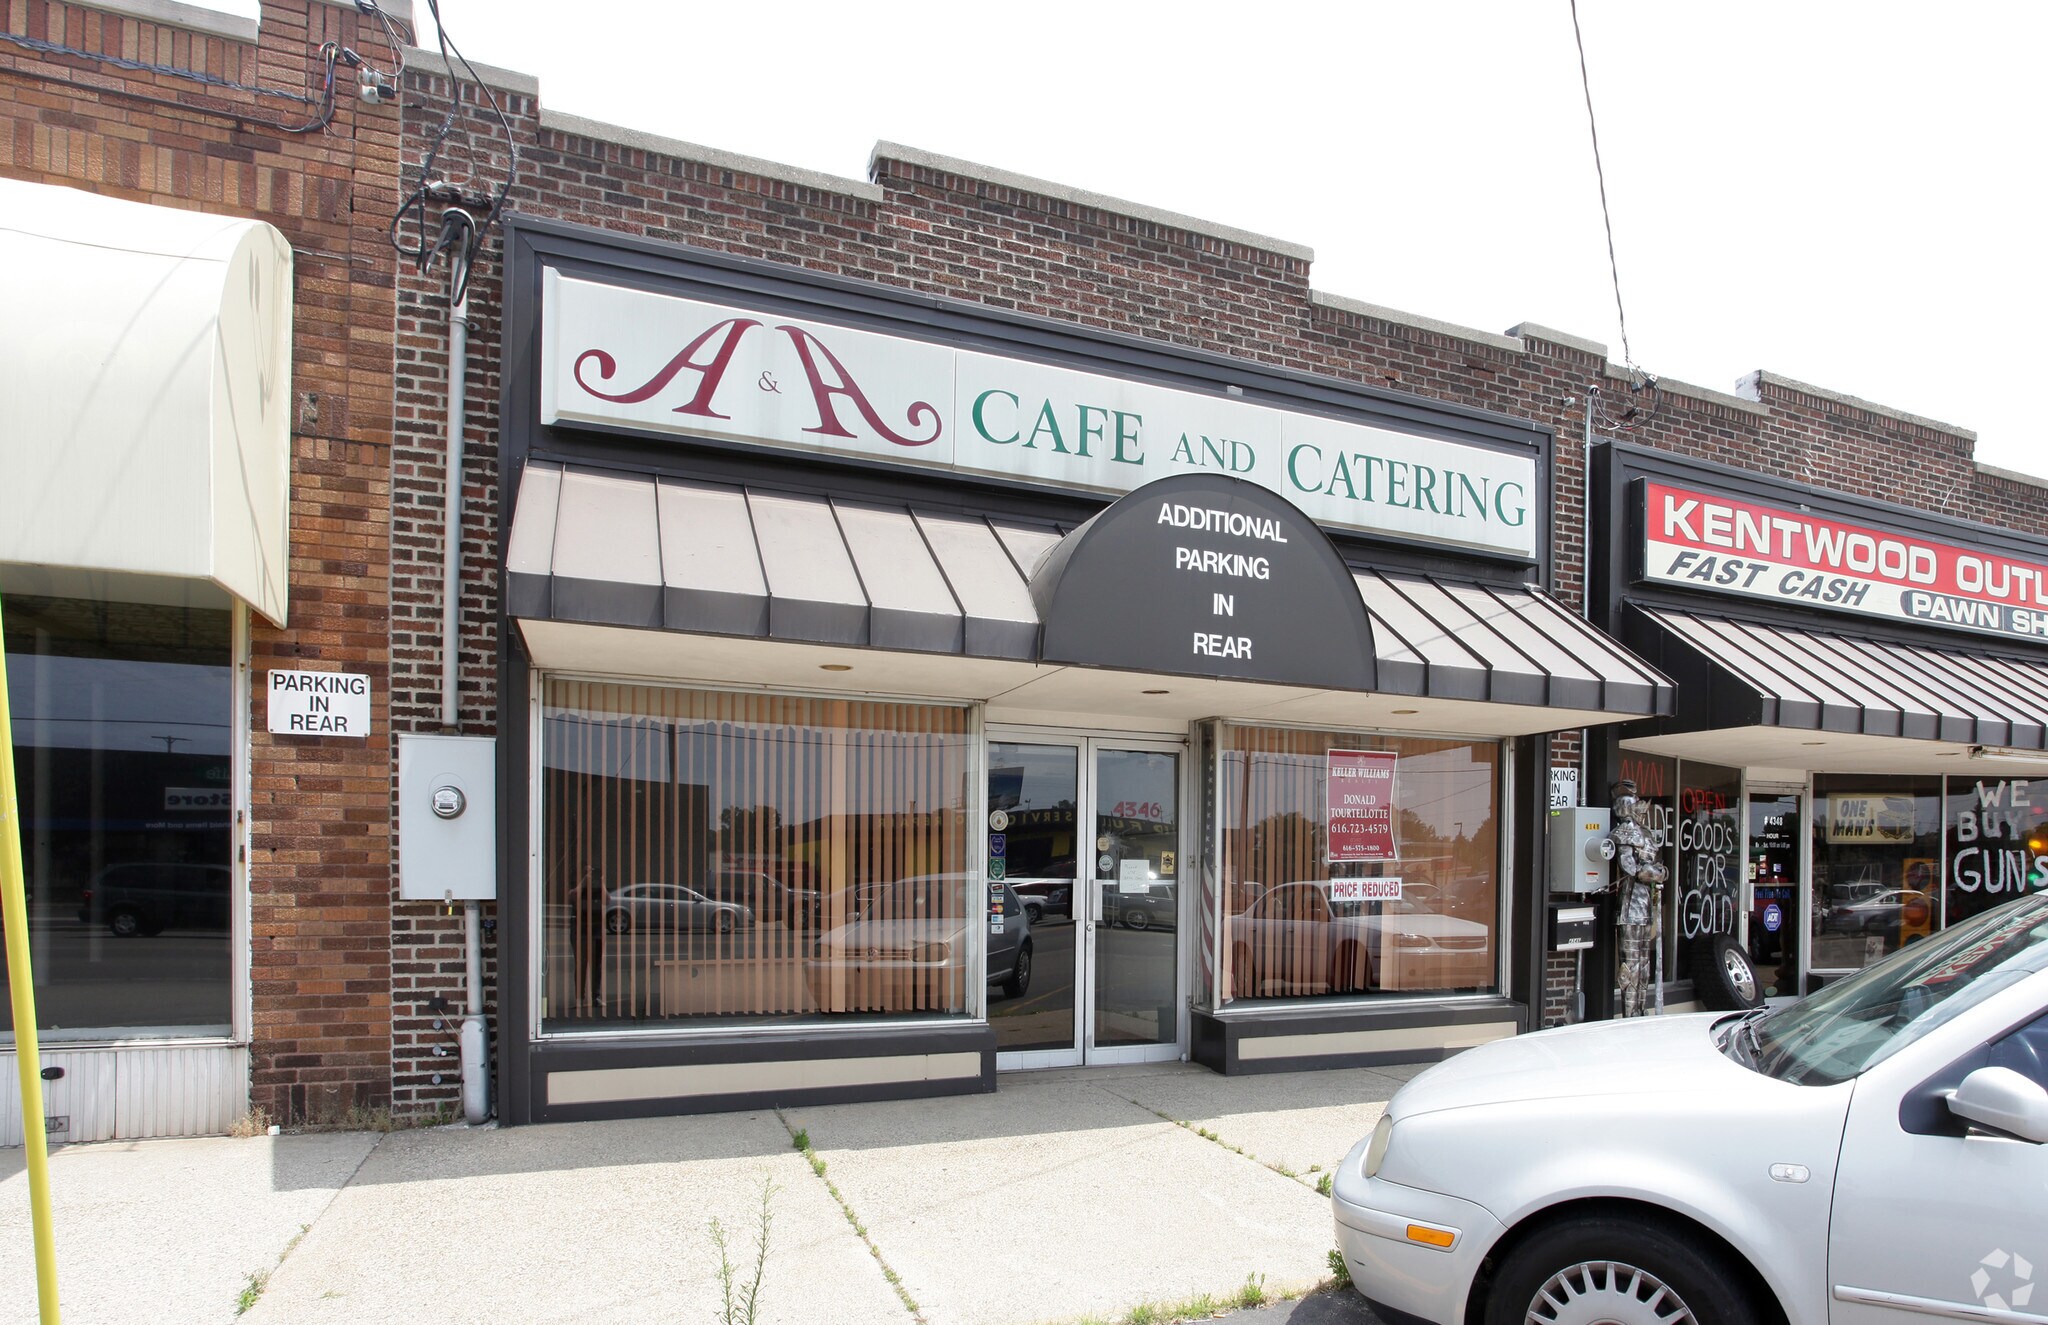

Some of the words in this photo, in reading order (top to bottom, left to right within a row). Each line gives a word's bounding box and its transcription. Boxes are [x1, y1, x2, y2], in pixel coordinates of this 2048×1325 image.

[574, 318, 764, 420] A
[758, 371, 782, 394] &
[775, 325, 942, 446] A
[971, 389, 1145, 466] CAFE
[1170, 432, 1256, 473] AND
[1287, 443, 1527, 527] CATERING
[1157, 502, 1288, 544] ADDITIONAL
[1664, 495, 1938, 585] KENTWOOD
[1956, 554, 2048, 606] OUTL
[1175, 547, 1270, 580] PARKING
[1666, 551, 1769, 589] FAST
[1778, 570, 1871, 607] CASH
[1911, 593, 1999, 629] PAWN
[1213, 594, 1233, 617] IN
[1193, 633, 1252, 660] REAR
[273, 673, 366, 696] PARKING
[309, 695, 329, 713] IN
[290, 714, 348, 733] REAR
[1332, 767, 1356, 777] KELLER
[1358, 768, 1390, 779] WILLIAMS
[1619, 759, 1664, 797] AWN
[1344, 794, 1376, 805] DONALD
[1551, 783, 1560, 794] IN
[1976, 780, 2031, 807] WE
[1113, 801, 1160, 818] 4346
[1550, 795, 1568, 806] EAR
[1682, 787, 1727, 816] OPEN
[1841, 800, 1868, 817] ONE
[1331, 808, 1389, 819] TOURTELLOTTE
[1331, 823, 1388, 834] 616.723-4579
[1680, 819, 1733, 854] GOOD'S
[1832, 819, 1875, 836] MAN'S
[1957, 811, 2024, 842] BUY
[1696, 854, 1727, 888] FOR
[1953, 847, 2048, 894] GUN'S
[1333, 881, 1358, 897] PRICE
[1362, 881, 1400, 897] REDUCED
[1766, 913, 1779, 921] ADT
